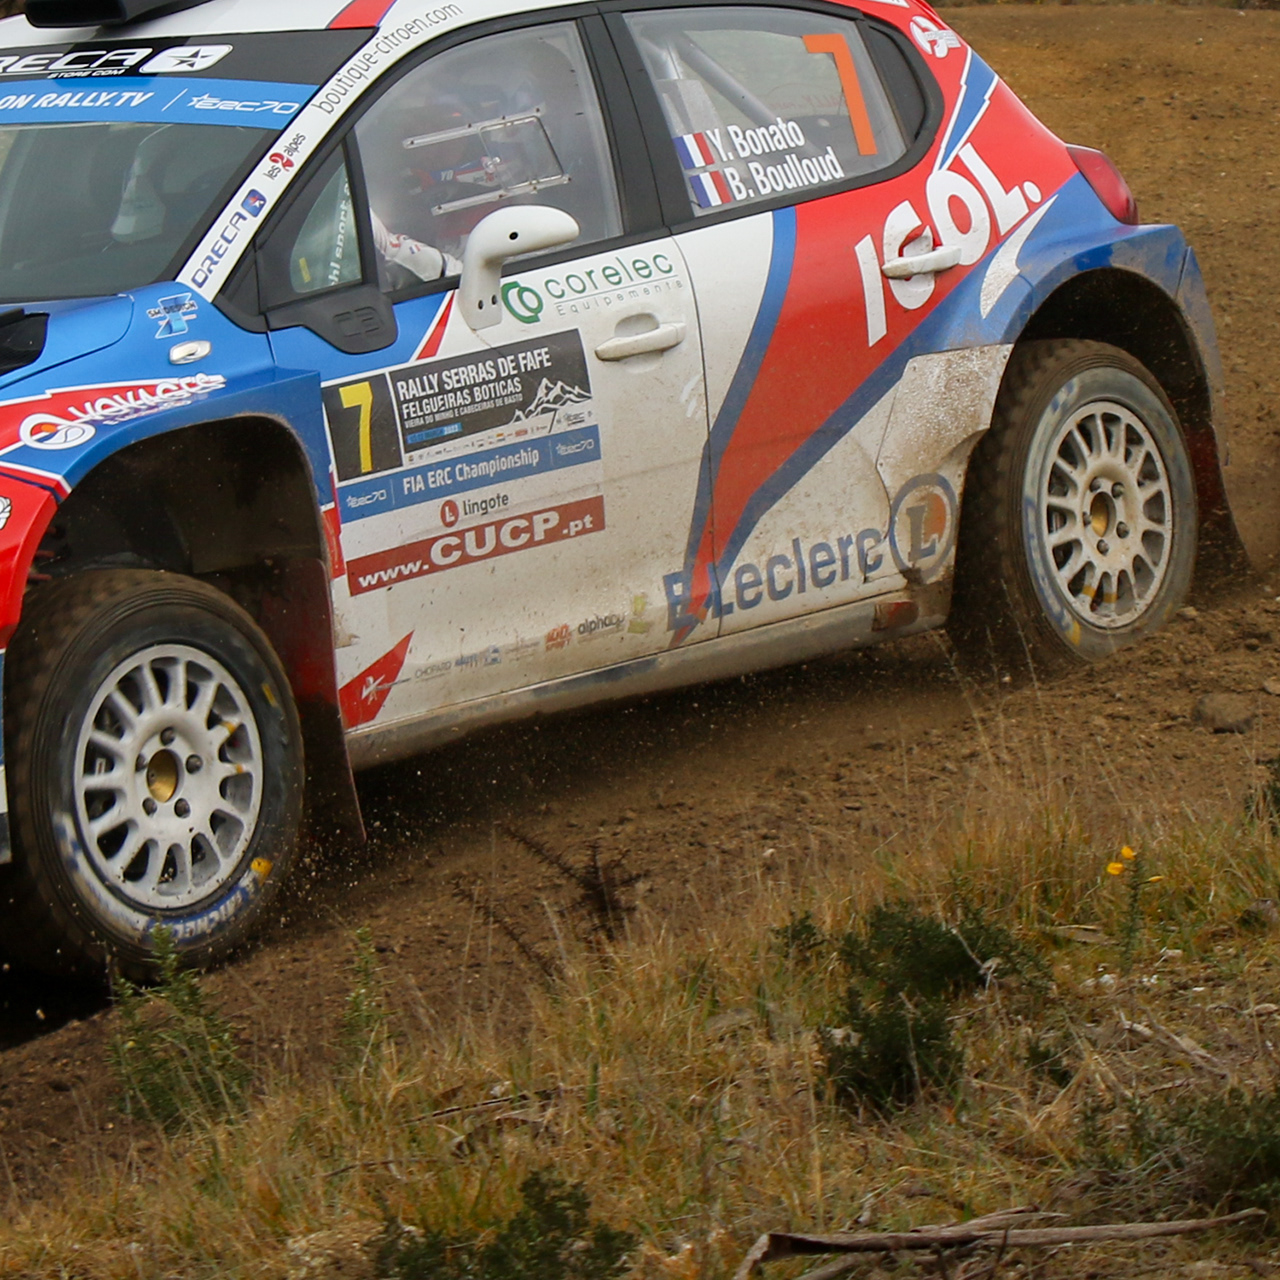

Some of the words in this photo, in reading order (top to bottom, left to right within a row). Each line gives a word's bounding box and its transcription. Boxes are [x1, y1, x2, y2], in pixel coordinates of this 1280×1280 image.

[311, 1, 464, 115] boutique-citroen.com
[32, 91, 156, 109] RALLY.TV
[802, 33, 878, 156] 7
[706, 128, 734, 162] Y.
[726, 117, 806, 159] Bonato
[723, 166, 755, 201] B.
[748, 145, 845, 195] Boulloud
[190, 210, 248, 289] ORECA
[543, 254, 674, 300] corelec
[555, 279, 684, 317] Equipements
[396, 373, 442, 402] RALLY
[441, 360, 498, 391] SERRAS
[498, 356, 519, 377] DE
[519, 346, 553, 373] FAFE
[402, 392, 472, 420] FELGUEIRAS
[472, 376, 523, 402] BOTICAS
[338, 381, 373, 473] 7
[403, 474, 424, 496] FIA
[427, 466, 453, 490] ERC
[455, 448, 540, 482] Championship
[463, 492, 509, 517] lingote
[357, 510, 594, 588] www.CUCP.pt
